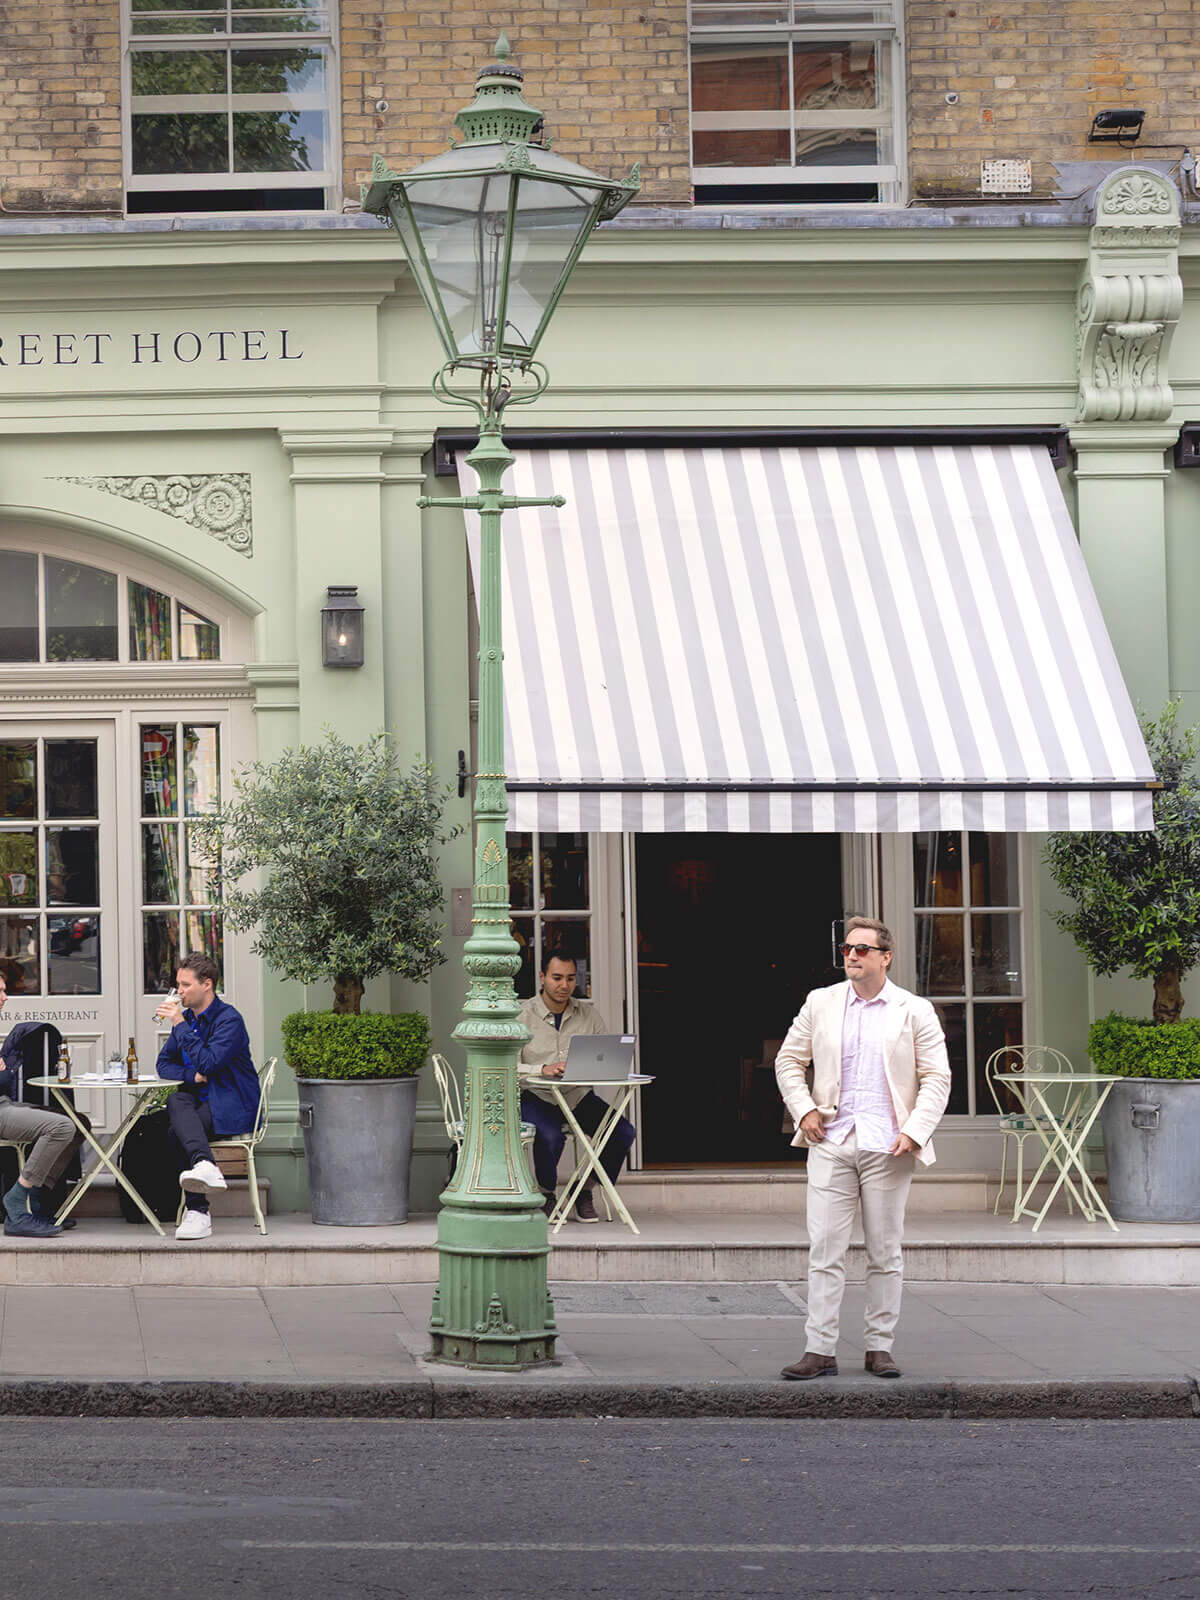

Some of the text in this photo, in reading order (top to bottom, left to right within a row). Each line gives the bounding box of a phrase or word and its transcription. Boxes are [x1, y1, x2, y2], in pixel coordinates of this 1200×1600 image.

[131, 329, 304, 364] HOTEL
[14, 1011, 22, 1021] &
[24, 1010, 99, 1021] RESTAURANT
